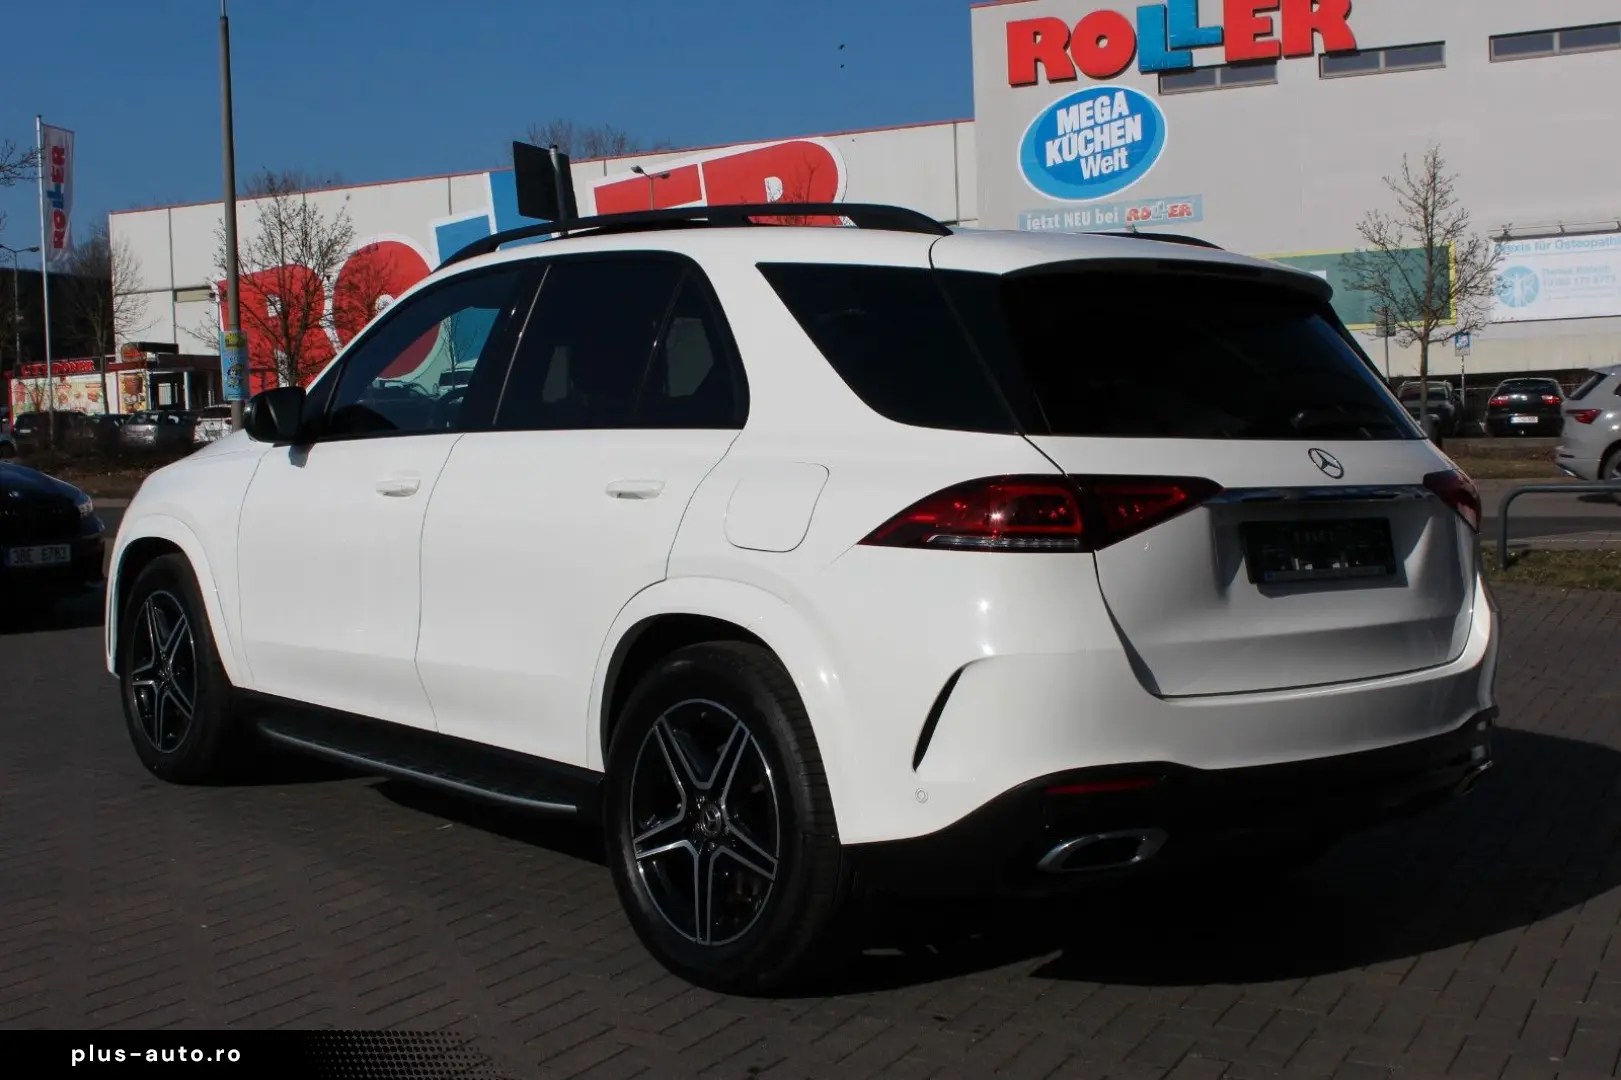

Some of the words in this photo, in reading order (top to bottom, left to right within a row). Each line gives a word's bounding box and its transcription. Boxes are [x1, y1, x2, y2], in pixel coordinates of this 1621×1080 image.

[1006, 0, 1357, 86] ROLLER
[1057, 90, 1130, 136] MEGA
[1045, 113, 1143, 168] KÜCHEN
[1080, 147, 1130, 180] Welt
[47, 146, 66, 249] ROLLER
[1026, 214, 1060, 231] jetzt
[1064, 210, 1091, 227] NEU
[1095, 207, 1119, 224] bei
[1125, 200, 1193, 222] ROLLER
[1534, 240, 1551, 251] für
